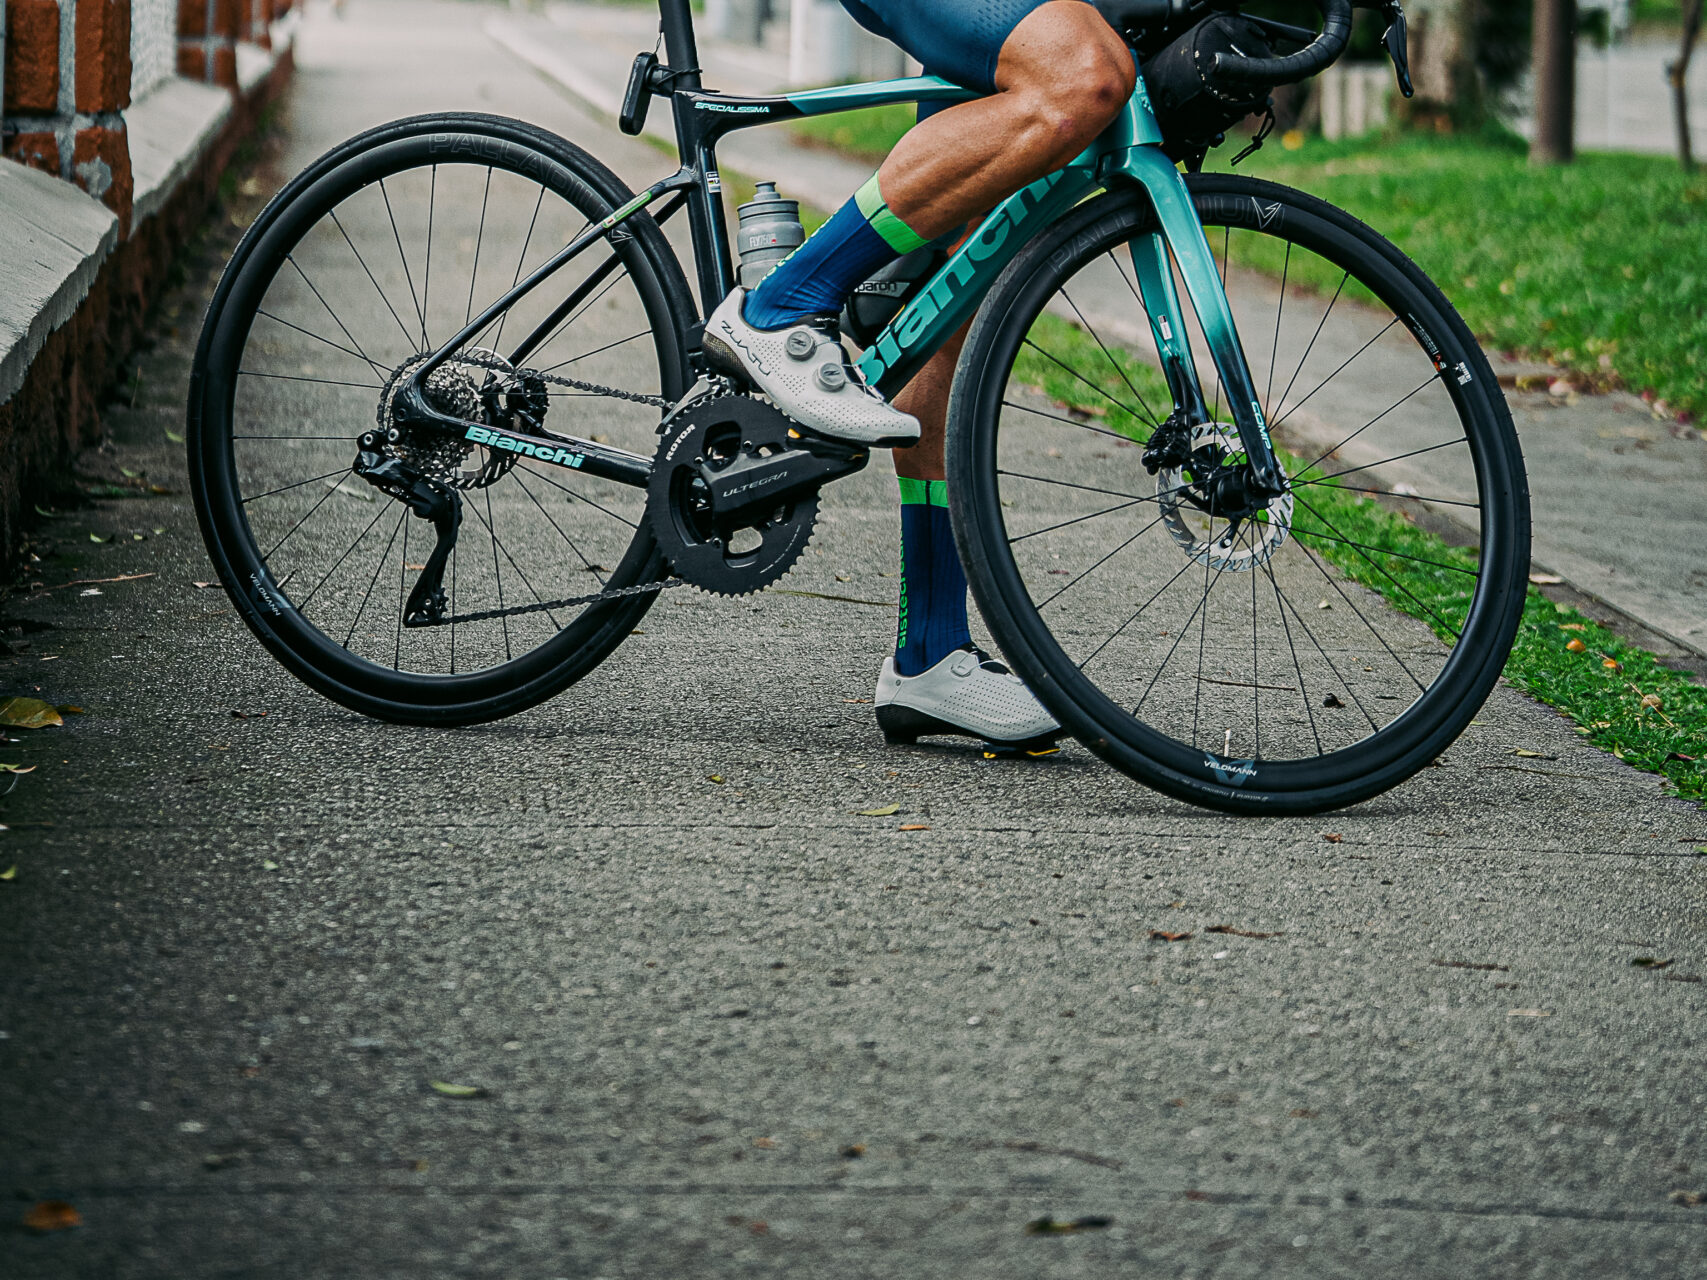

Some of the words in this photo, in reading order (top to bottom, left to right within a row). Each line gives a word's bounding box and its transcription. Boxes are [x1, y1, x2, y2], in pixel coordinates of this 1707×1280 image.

[694, 101, 770, 114] SPECIALISSIMA
[665, 423, 696, 462] ROTOR
[1251, 401, 1272, 450] COMP
[464, 425, 587, 468] Bianchi
[722, 471, 788, 498] ULTEGRA
[249, 572, 281, 617] VELOMANN
[1203, 760, 1258, 777] VELOMANN
